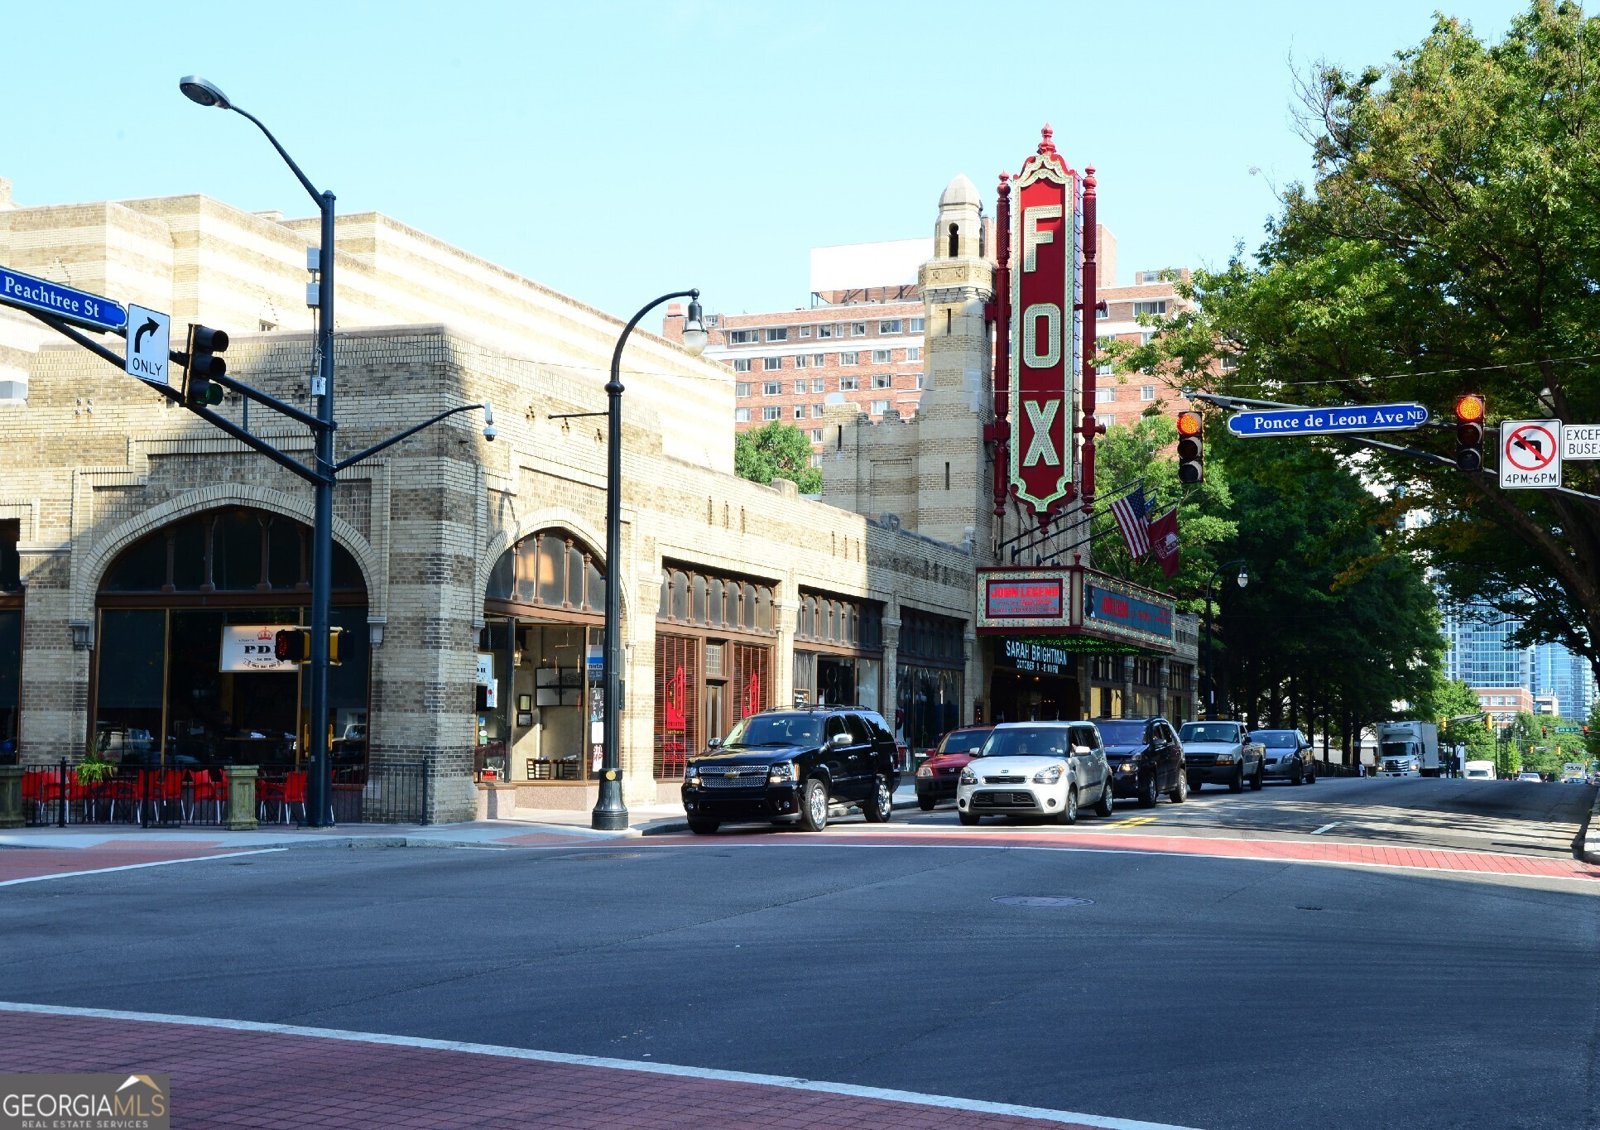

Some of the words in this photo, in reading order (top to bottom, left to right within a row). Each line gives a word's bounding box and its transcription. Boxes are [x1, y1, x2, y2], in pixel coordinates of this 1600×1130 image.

[4, 276, 80, 312] Peachtree
[84, 299, 100, 318] St
[1022, 203, 1062, 467] FOX
[132, 357, 163, 377] ONLY
[1254, 416, 1299, 430] Ponce
[1304, 414, 1323, 428] de
[1328, 413, 1367, 426] Leon
[1373, 410, 1404, 424] Ave
[1407, 410, 1424, 421] NE
[1568, 443, 1600, 455] BUSE
[1505, 473, 1557, 484] 4PM-6PM
[244, 645, 277, 655] PD
[1005, 640, 1030, 660] SARAH
[1031, 644, 1067, 666] BRIGHTMAN
